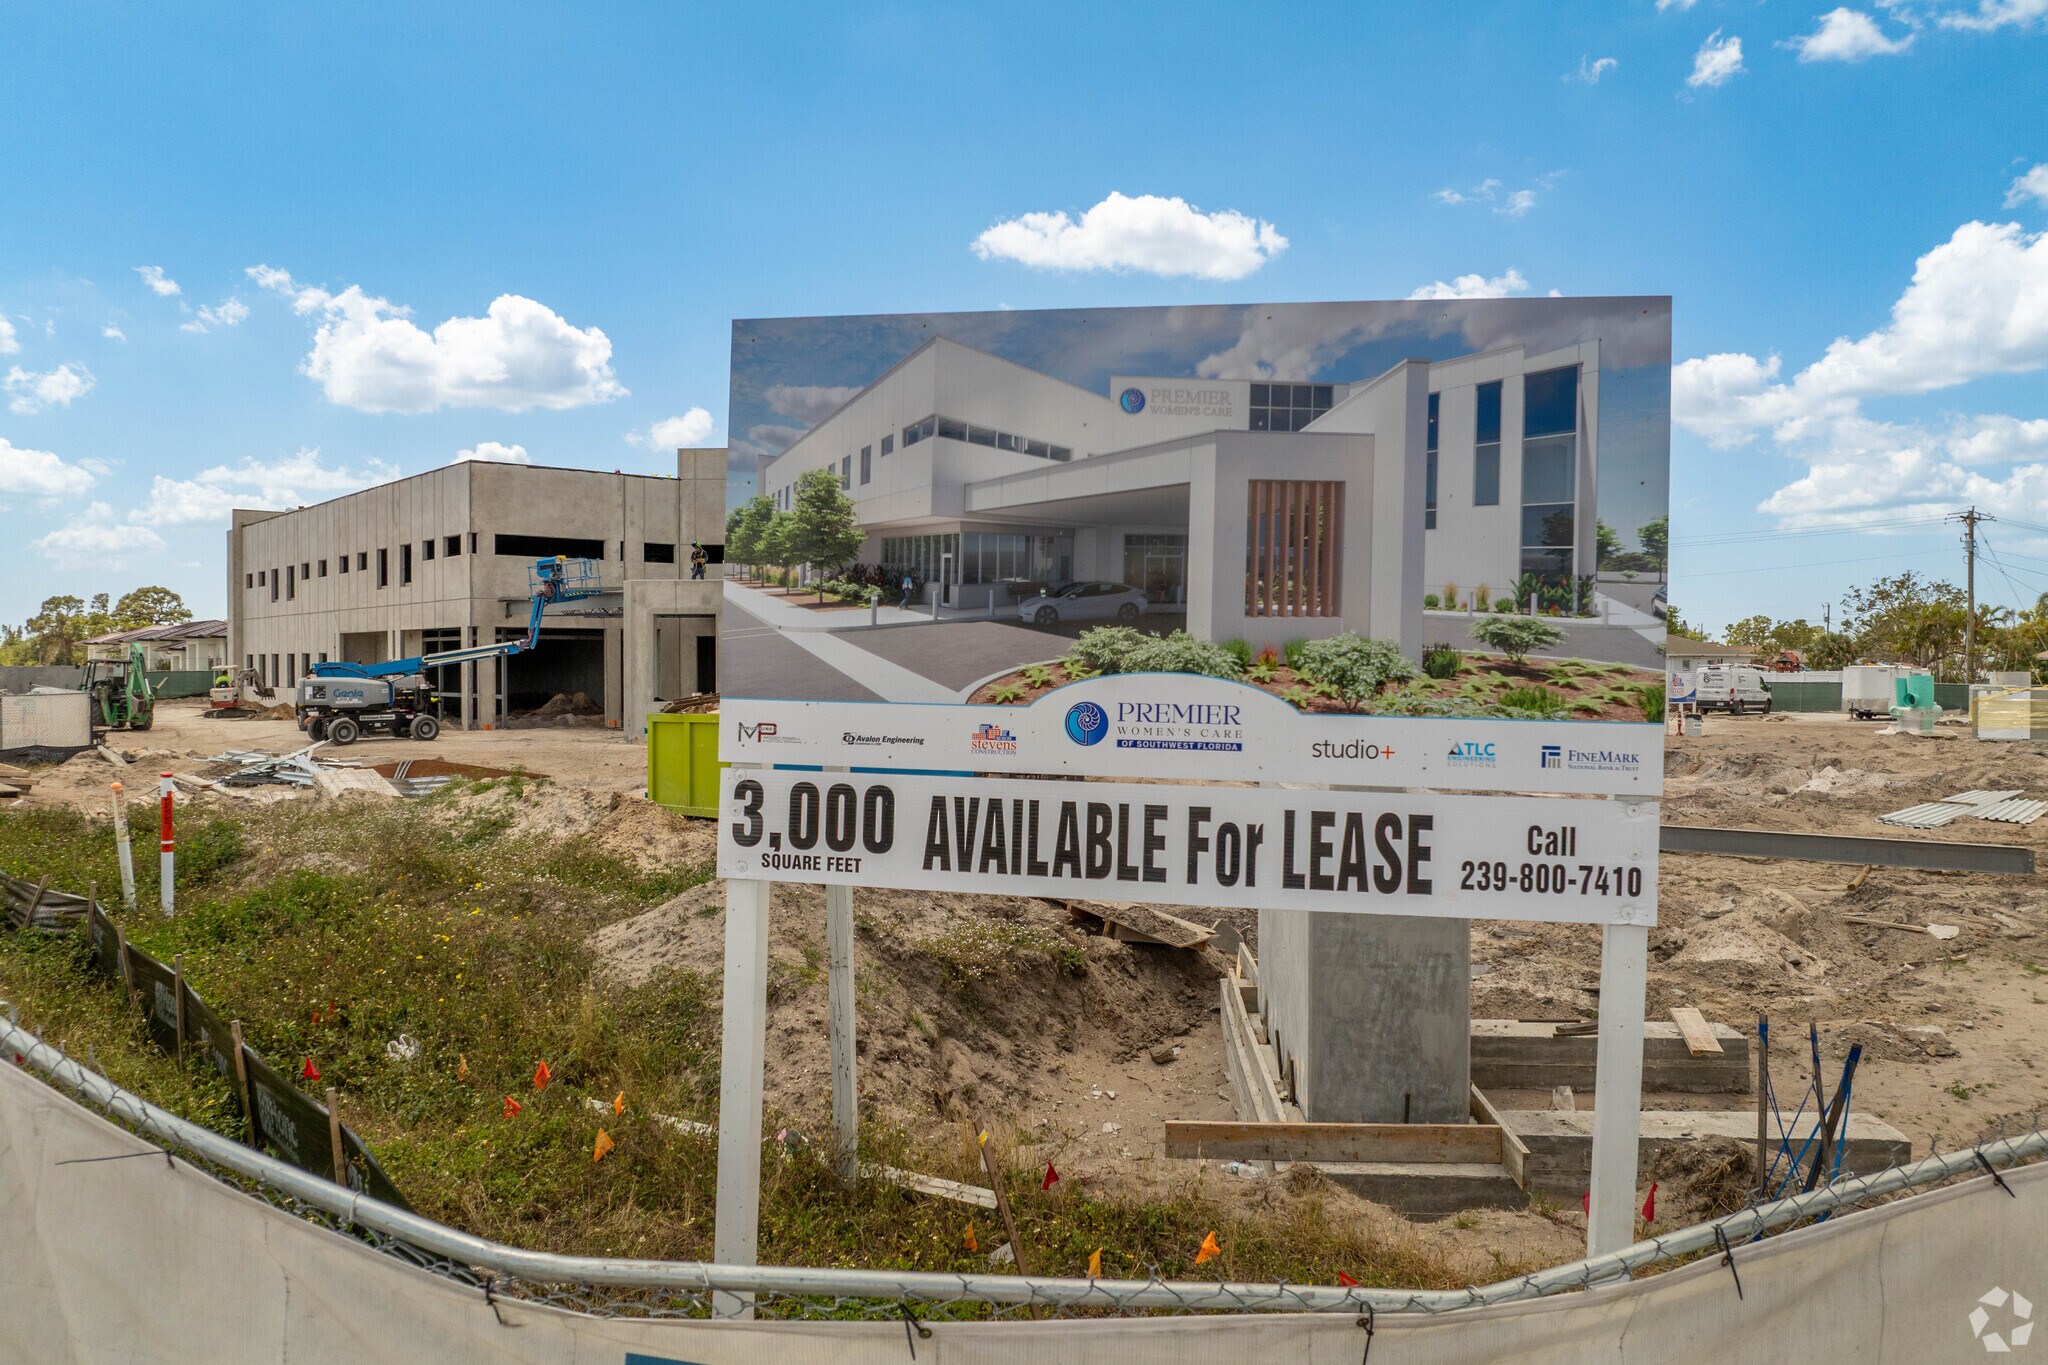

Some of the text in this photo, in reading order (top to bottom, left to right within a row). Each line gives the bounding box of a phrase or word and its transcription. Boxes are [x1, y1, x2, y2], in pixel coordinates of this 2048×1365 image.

[1151, 389, 1233, 406] PREMIER
[1150, 405, 1233, 417] WOMEN'S CARE
[333, 688, 364, 698] Genie
[1117, 702, 1242, 726] PREMIER
[856, 735, 880, 743] Avalon
[882, 736, 925, 746] Engineering
[1117, 726, 1243, 739] WOMEN'S CARE
[971, 740, 1017, 751] stevens
[1121, 740, 1238, 751] OF SOUTHWEST FLORIDA
[1464, 742, 1496, 757] TLC
[732, 779, 895, 854] 3,000
[922, 795, 1434, 895] AVAILABLE For LEASE
[1527, 825, 1577, 857] Call
[761, 853, 862, 873] SQUARE FEET
[1459, 861, 1642, 897] 239-800-7410
